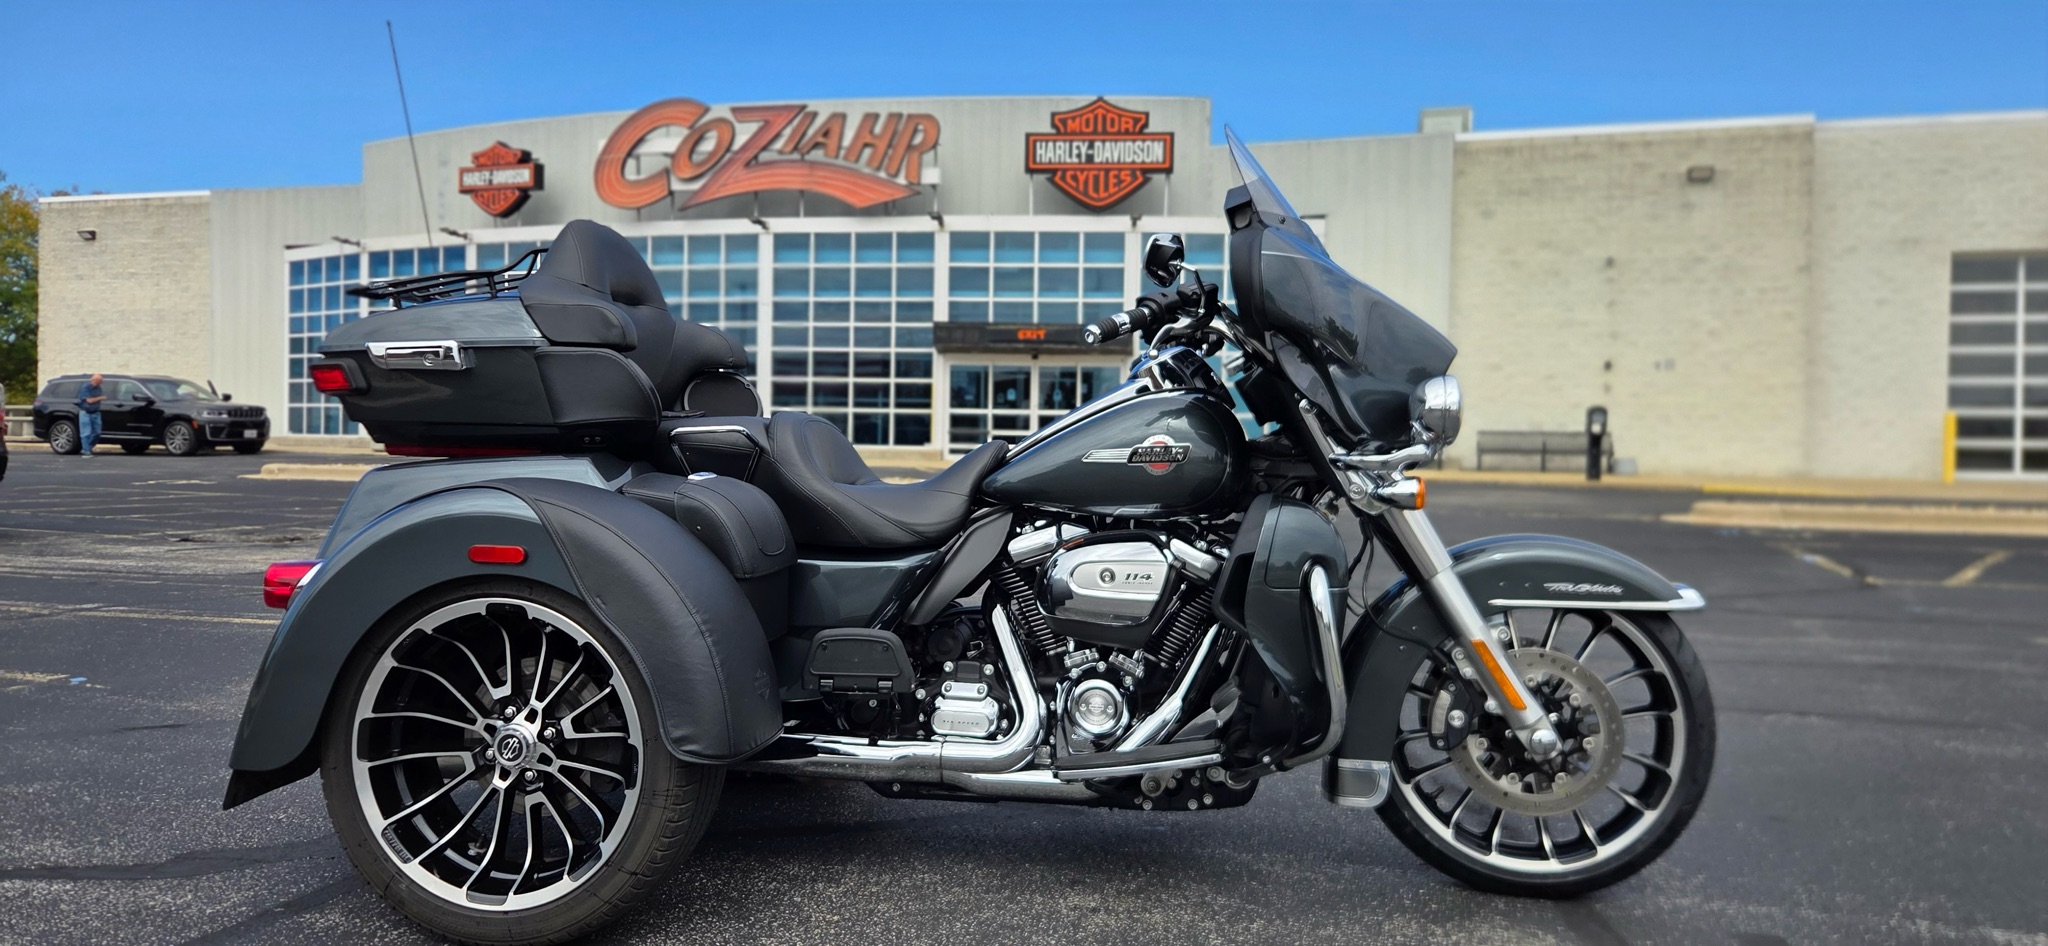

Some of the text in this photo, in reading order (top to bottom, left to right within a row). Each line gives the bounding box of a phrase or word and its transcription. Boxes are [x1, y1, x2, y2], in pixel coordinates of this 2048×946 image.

[1066, 109, 1134, 133] MOTOR
[1035, 140, 1164, 163] HARLEY-DAVIDSON
[1065, 170, 1132, 198] CYCLES
